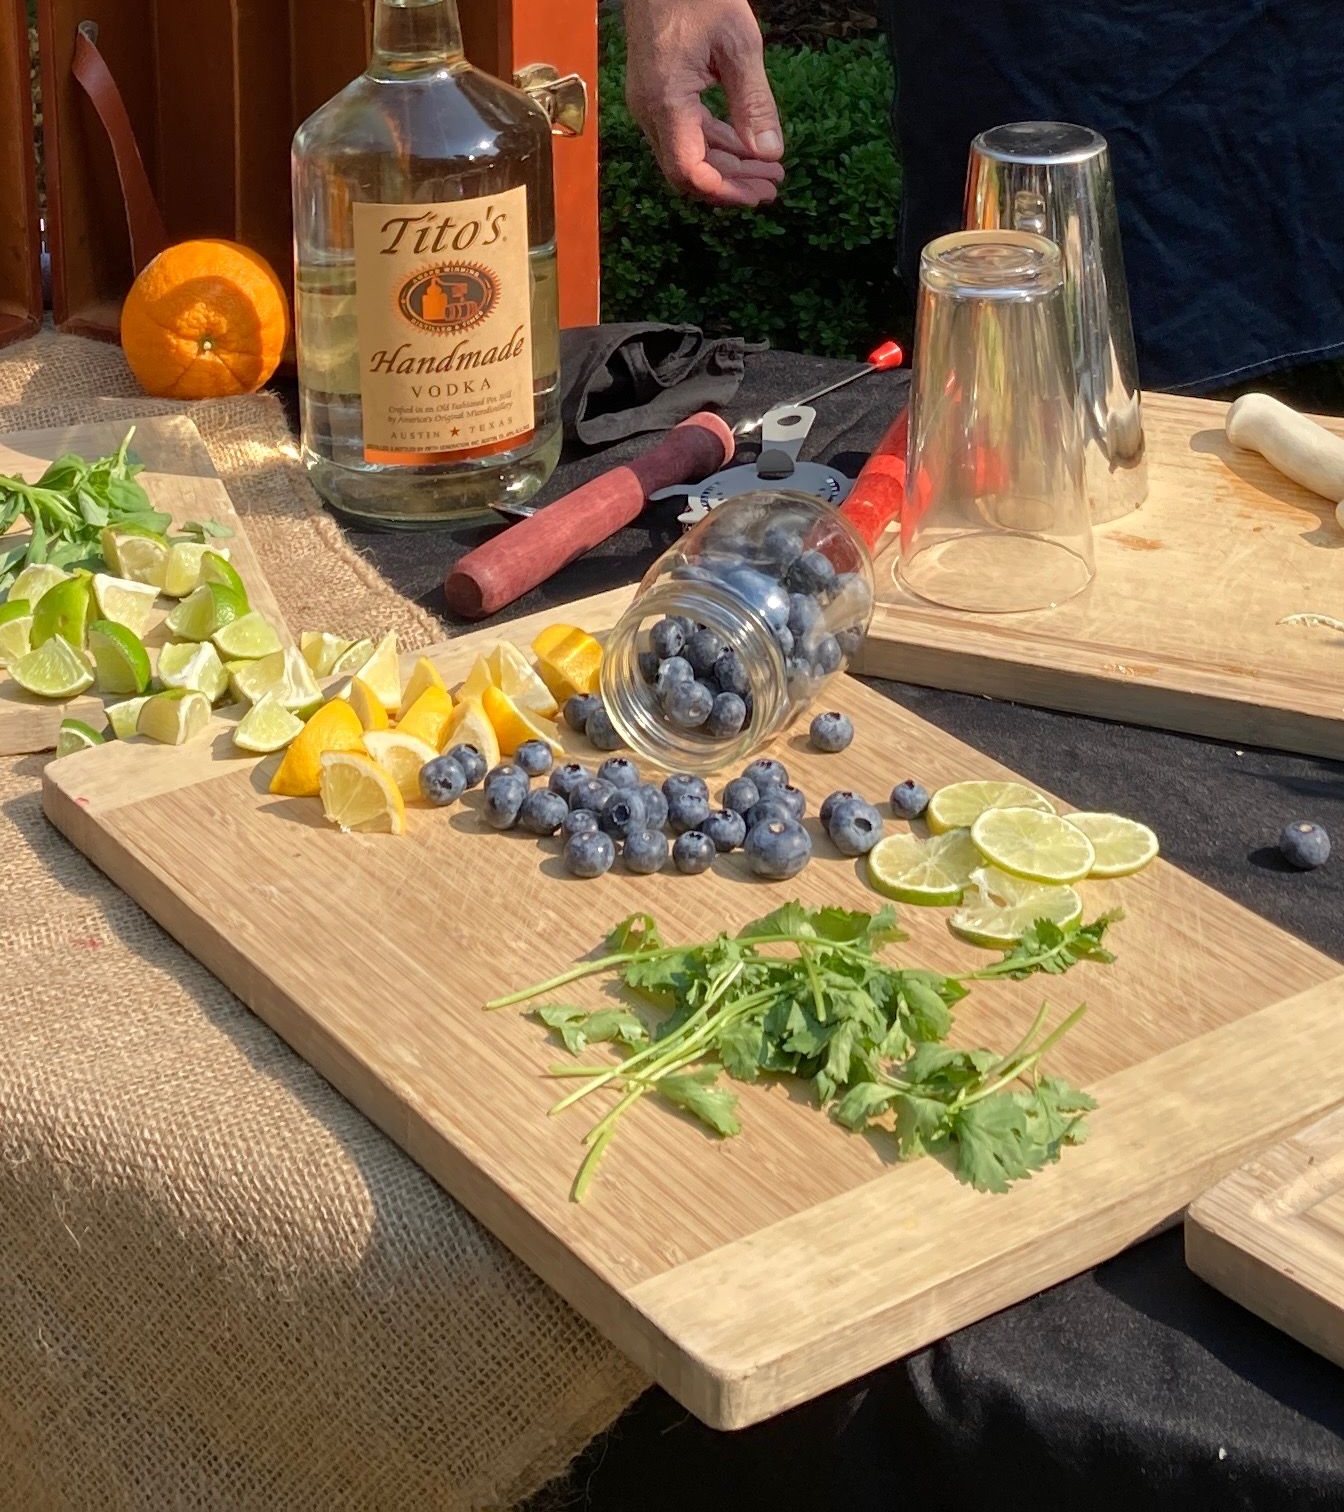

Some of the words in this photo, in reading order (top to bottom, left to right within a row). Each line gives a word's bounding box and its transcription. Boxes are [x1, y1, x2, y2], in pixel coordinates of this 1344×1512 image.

[379, 205, 507, 255] Tito's
[369, 324, 526, 375] Handmade
[411, 377, 492, 398] VODKA
[390, 431, 440, 440] AUSTIN
[468, 417, 513, 434] TEXAS
